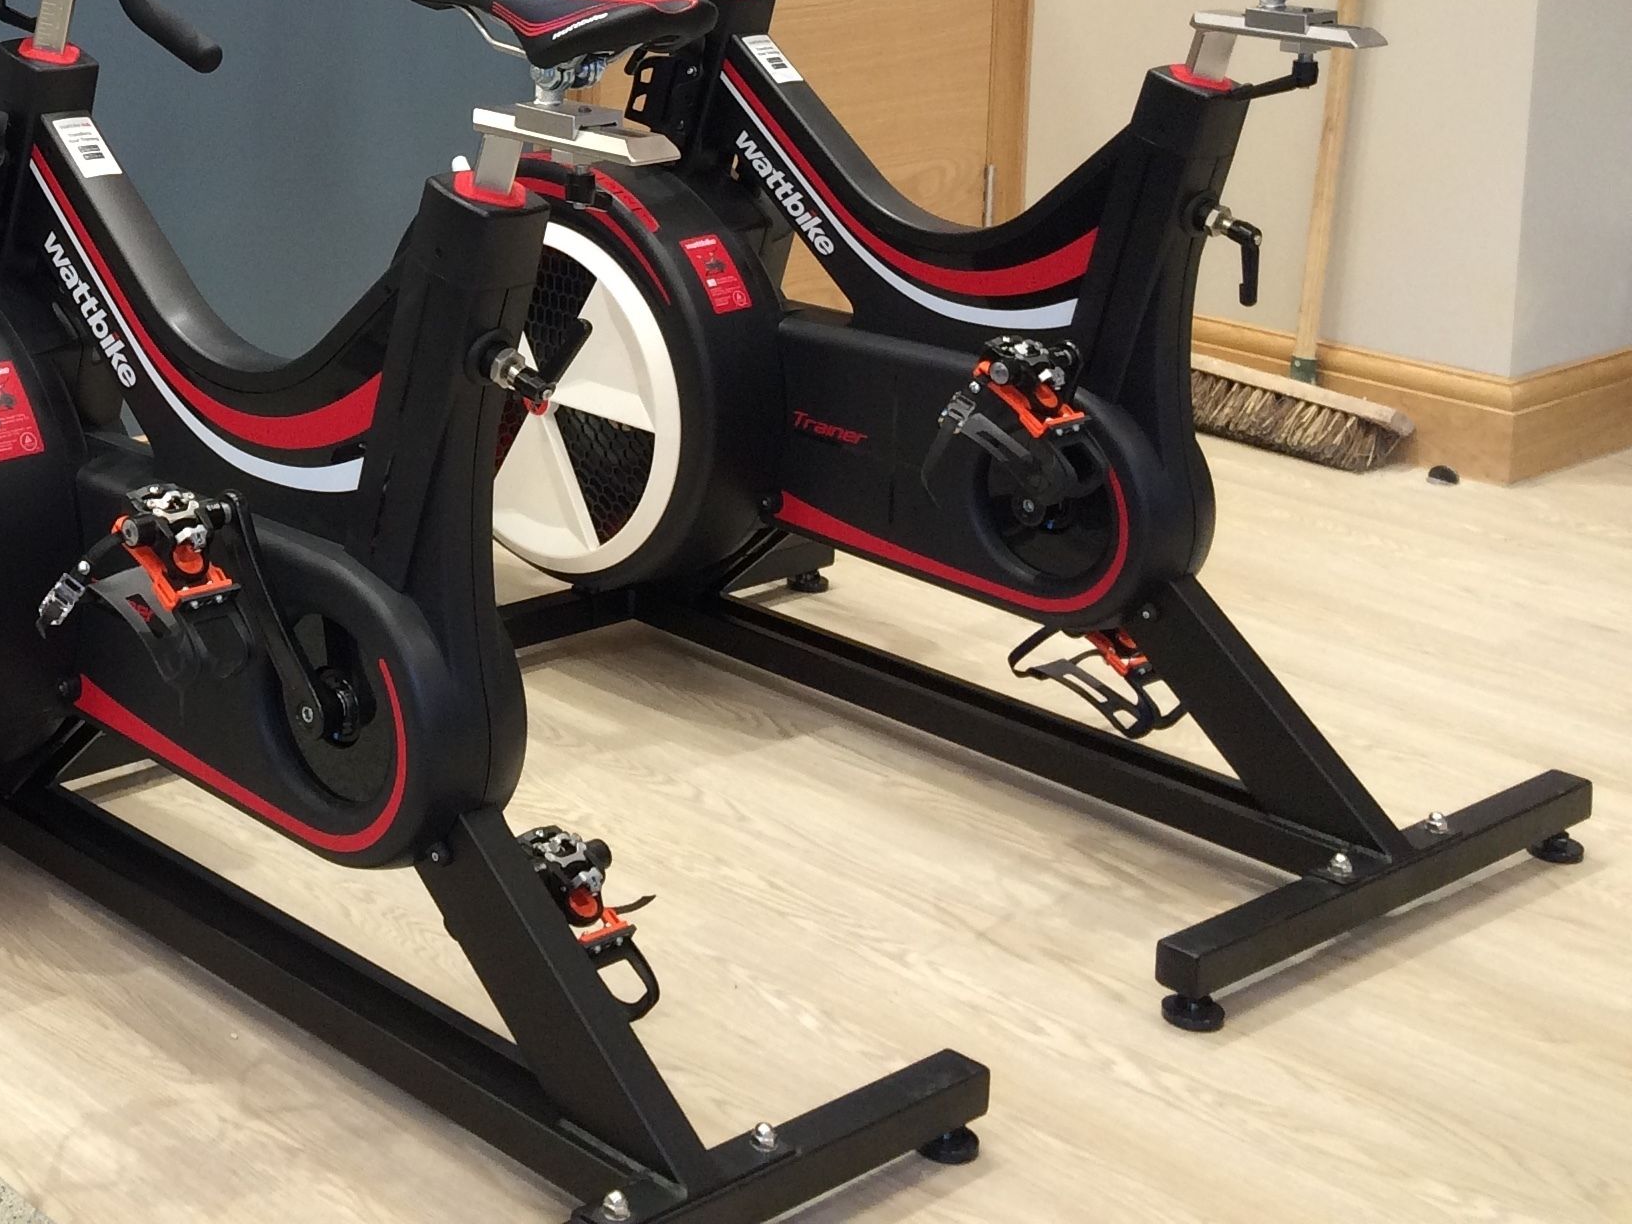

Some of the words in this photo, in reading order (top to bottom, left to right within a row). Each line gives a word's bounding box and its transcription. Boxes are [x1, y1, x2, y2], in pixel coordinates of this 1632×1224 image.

[735, 130, 835, 256] wattbike
[44, 231, 136, 388] wattbike
[794, 410, 868, 445] Trainer
